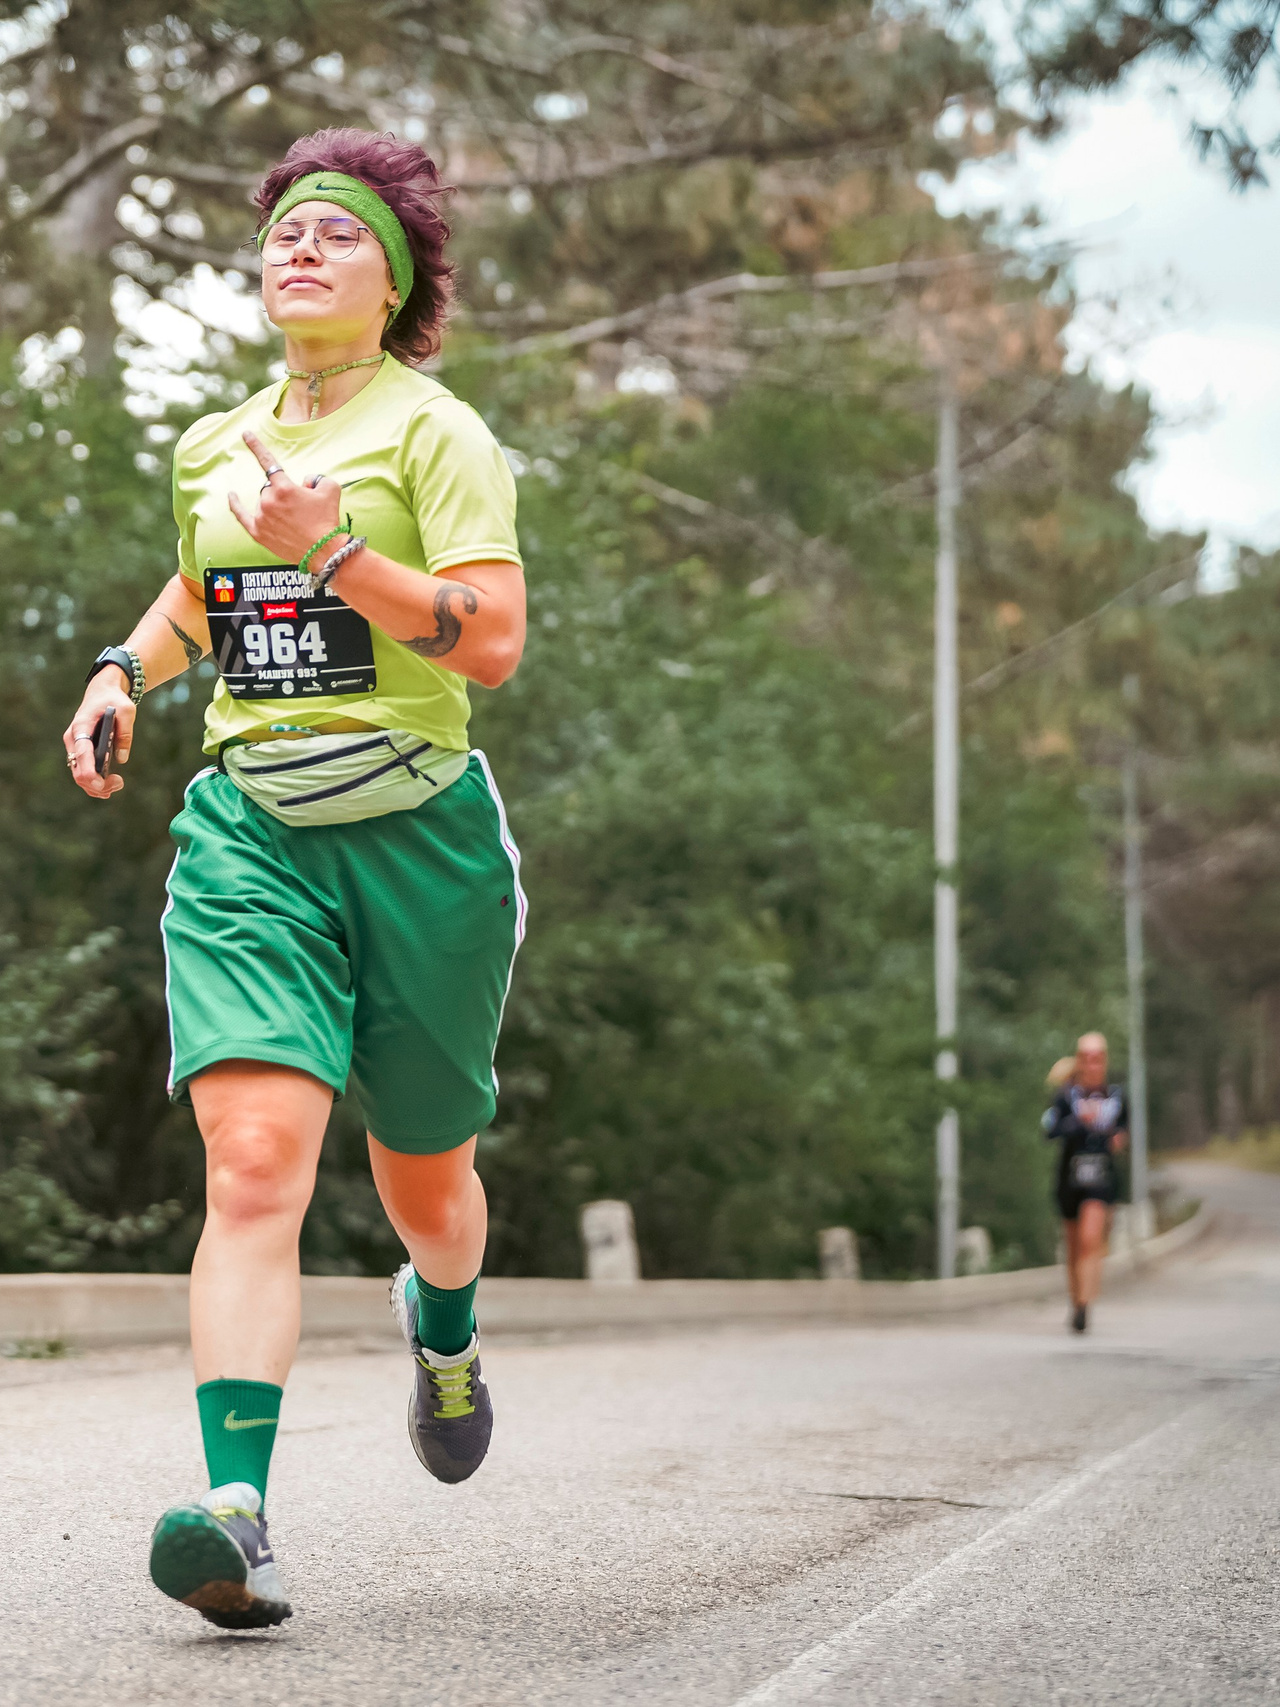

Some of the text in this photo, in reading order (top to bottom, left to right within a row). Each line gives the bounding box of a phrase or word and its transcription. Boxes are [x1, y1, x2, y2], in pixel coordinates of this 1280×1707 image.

[243, 585, 315, 602] ПОЛУМАРАФОН
[243, 621, 328, 665] 964
[258, 668, 318, 680] МАШУК 993
